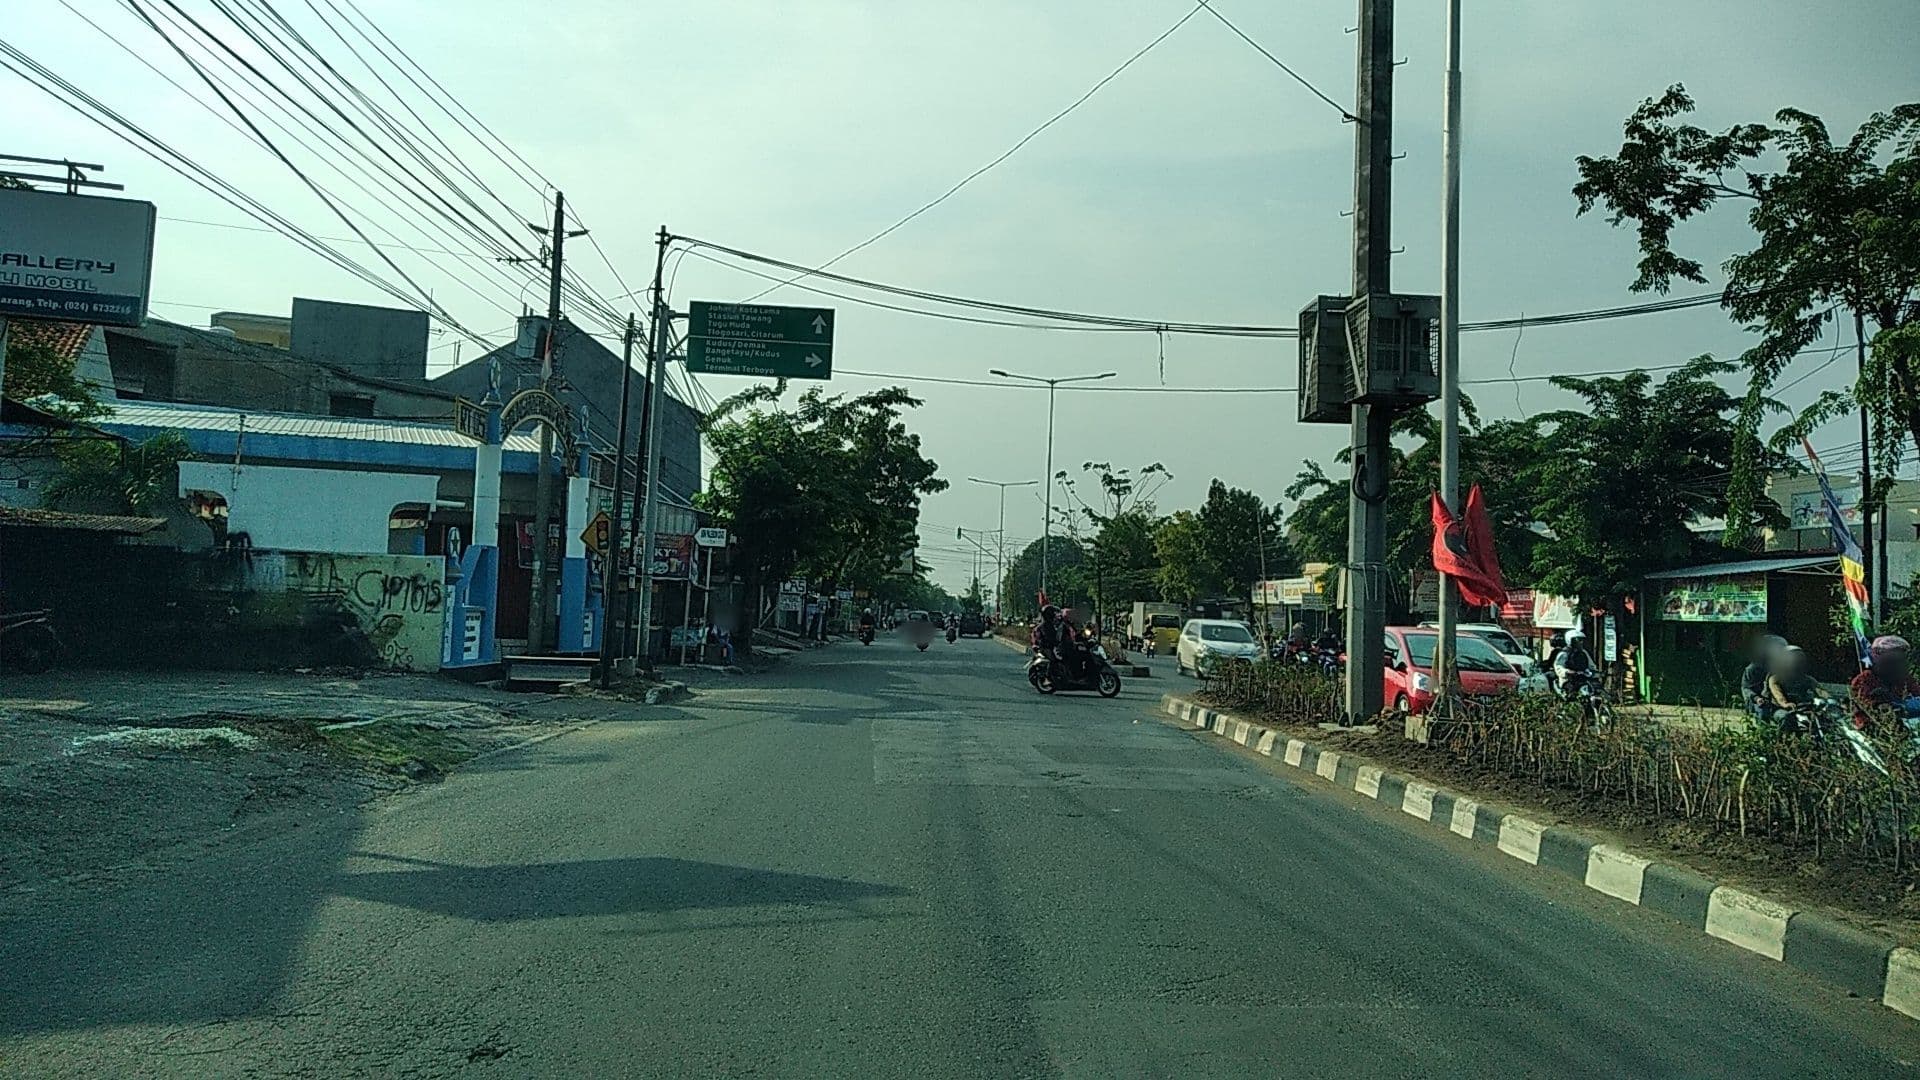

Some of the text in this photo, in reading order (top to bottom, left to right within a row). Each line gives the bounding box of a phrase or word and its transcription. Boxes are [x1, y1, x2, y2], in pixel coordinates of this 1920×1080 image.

[0, 252, 117, 274] ALLERY
[25, 273, 98, 291] MOBIL
[707, 312, 772, 323] Stasiun Tawang
[707, 321, 728, 330] Tugu
[704, 356, 732, 364] Genuk
[704, 364, 775, 375] Terminal Terboyo
